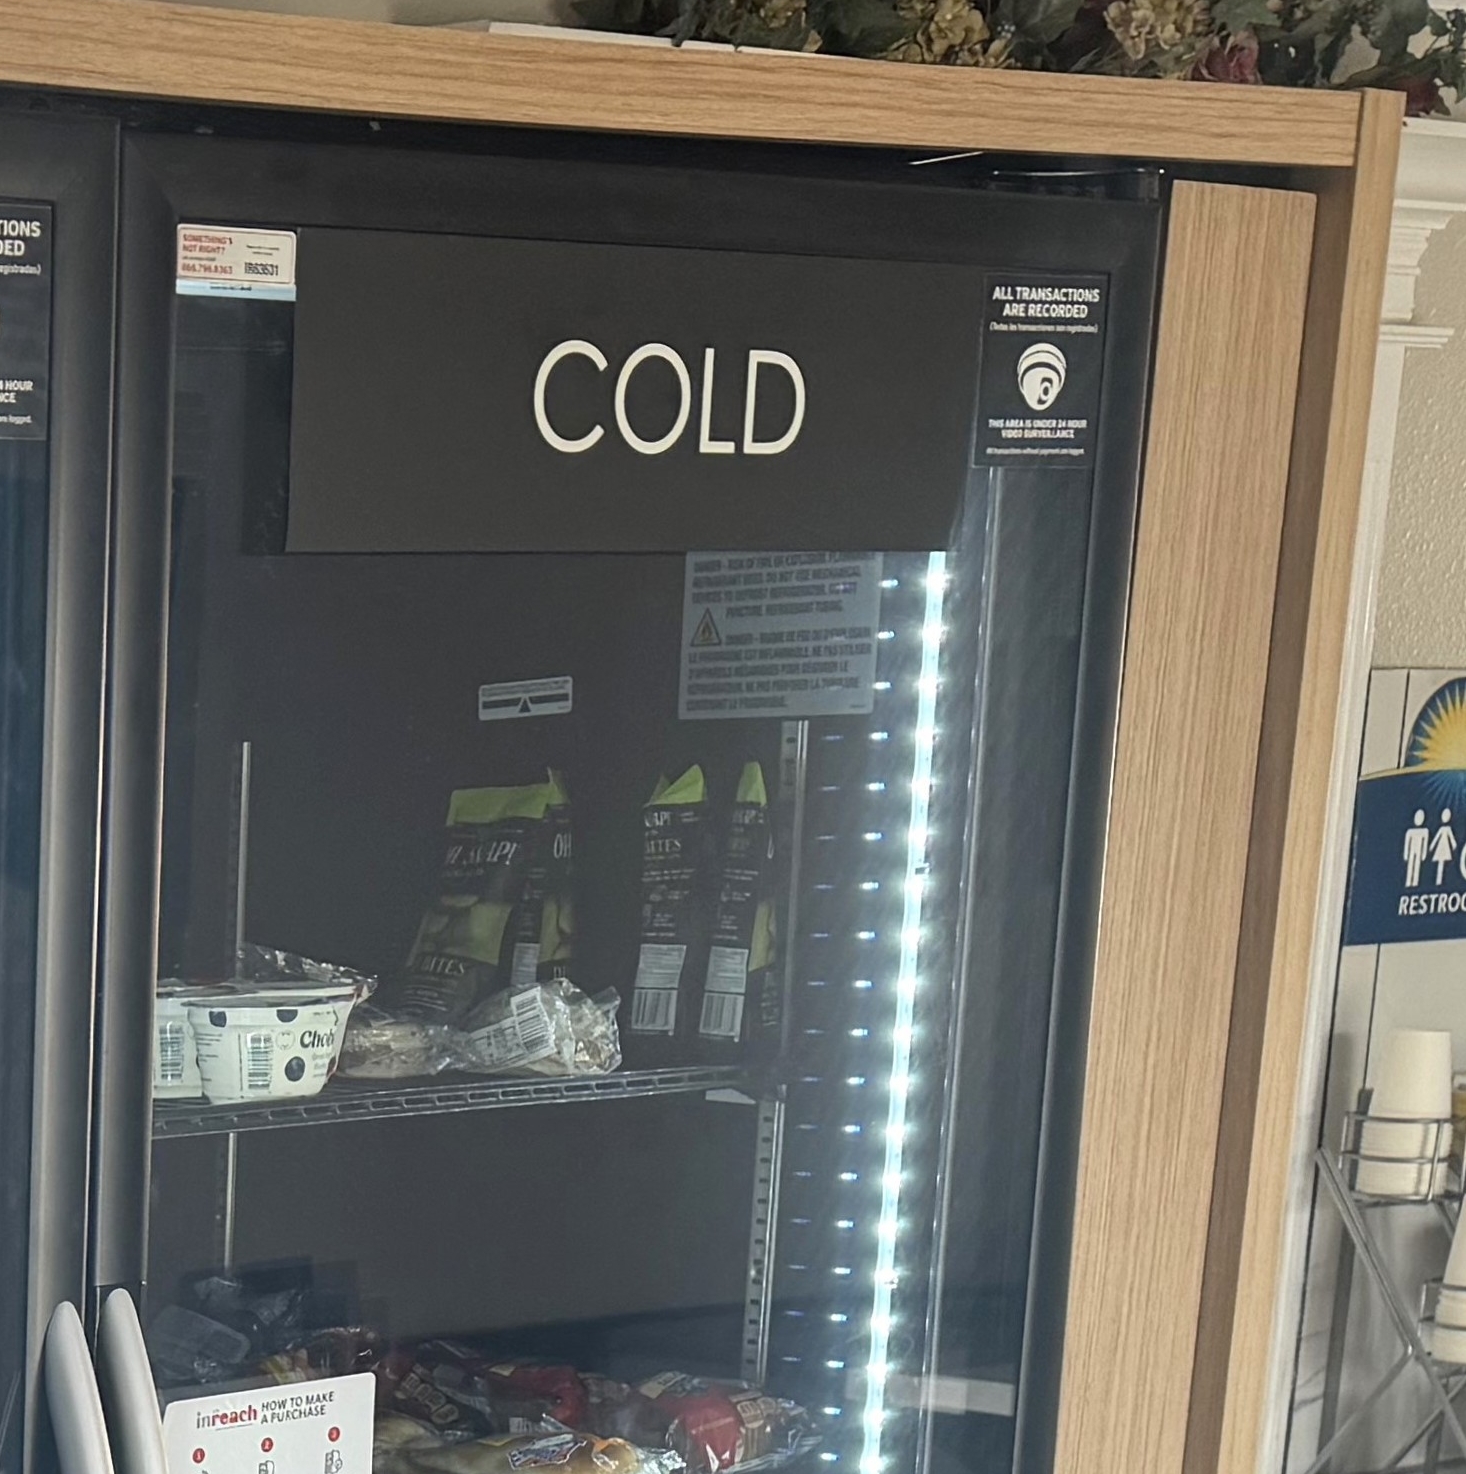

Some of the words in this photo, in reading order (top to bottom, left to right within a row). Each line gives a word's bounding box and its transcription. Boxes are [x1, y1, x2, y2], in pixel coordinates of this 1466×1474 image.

[992, 286, 1013, 300] ALL
[1015, 287, 1100, 302] TRANSACTIONS
[1003, 303, 1026, 317] ARE
[1028, 304, 1088, 318] RECORDED
[5, 381, 33, 391] HOUR
[534, 339, 805, 454] COLD
[262, 1398, 287, 1411] HOW
[289, 1396, 303, 1408] TO
[305, 1391, 334, 1405] MAKE
[196, 1405, 257, 1428] inreach
[261, 1413, 268, 1424] A
[271, 1405, 326, 1423] PURCHASE
